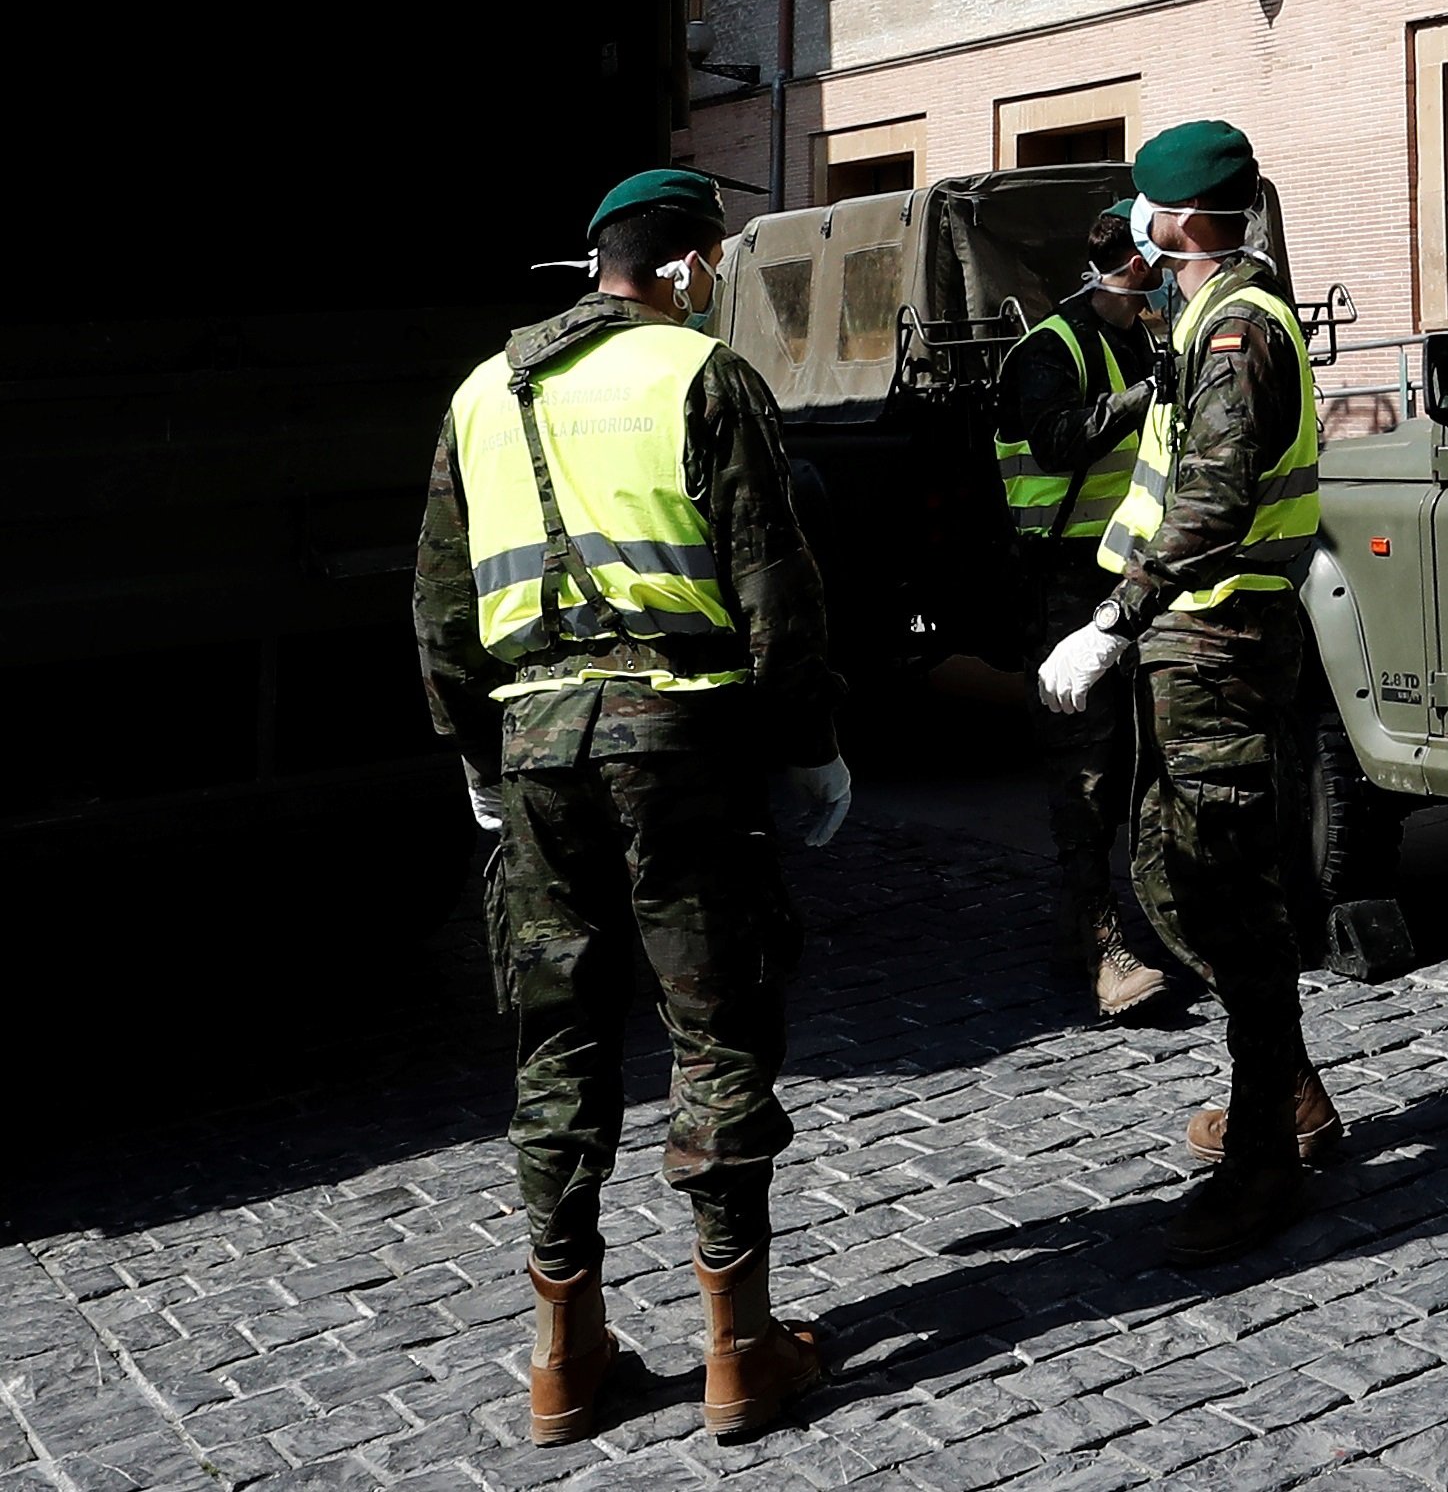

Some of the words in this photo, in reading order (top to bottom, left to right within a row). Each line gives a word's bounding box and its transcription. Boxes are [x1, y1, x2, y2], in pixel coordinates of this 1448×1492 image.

[571, 417, 654, 437] AUTORIDAD
[1381, 671, 1401, 686] 2.8
[1402, 673, 1420, 689] TD
